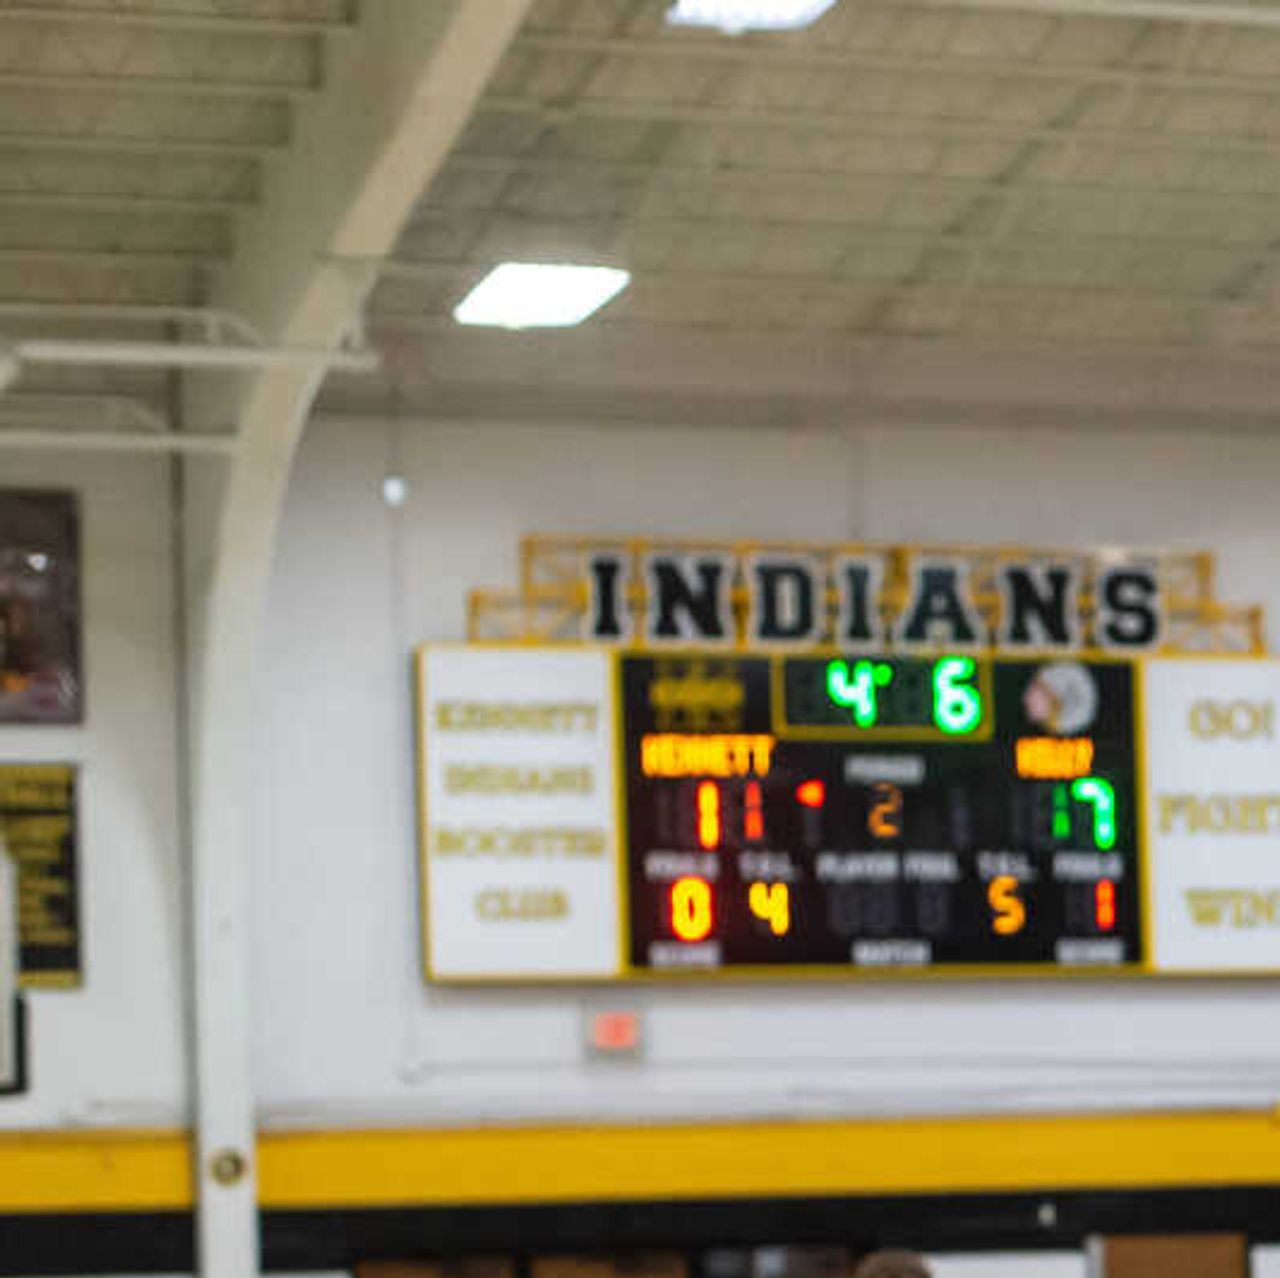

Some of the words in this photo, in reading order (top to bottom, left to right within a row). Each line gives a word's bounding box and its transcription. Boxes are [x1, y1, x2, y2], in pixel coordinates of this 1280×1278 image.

[587, 557, 1163, 650] INDIANS
[867, 782, 903, 838] 2
[669, 875, 713, 943] 0
[749, 880, 789, 936] 4
[987, 874, 1027, 936] 5
[1094, 877, 1117, 931] 1
